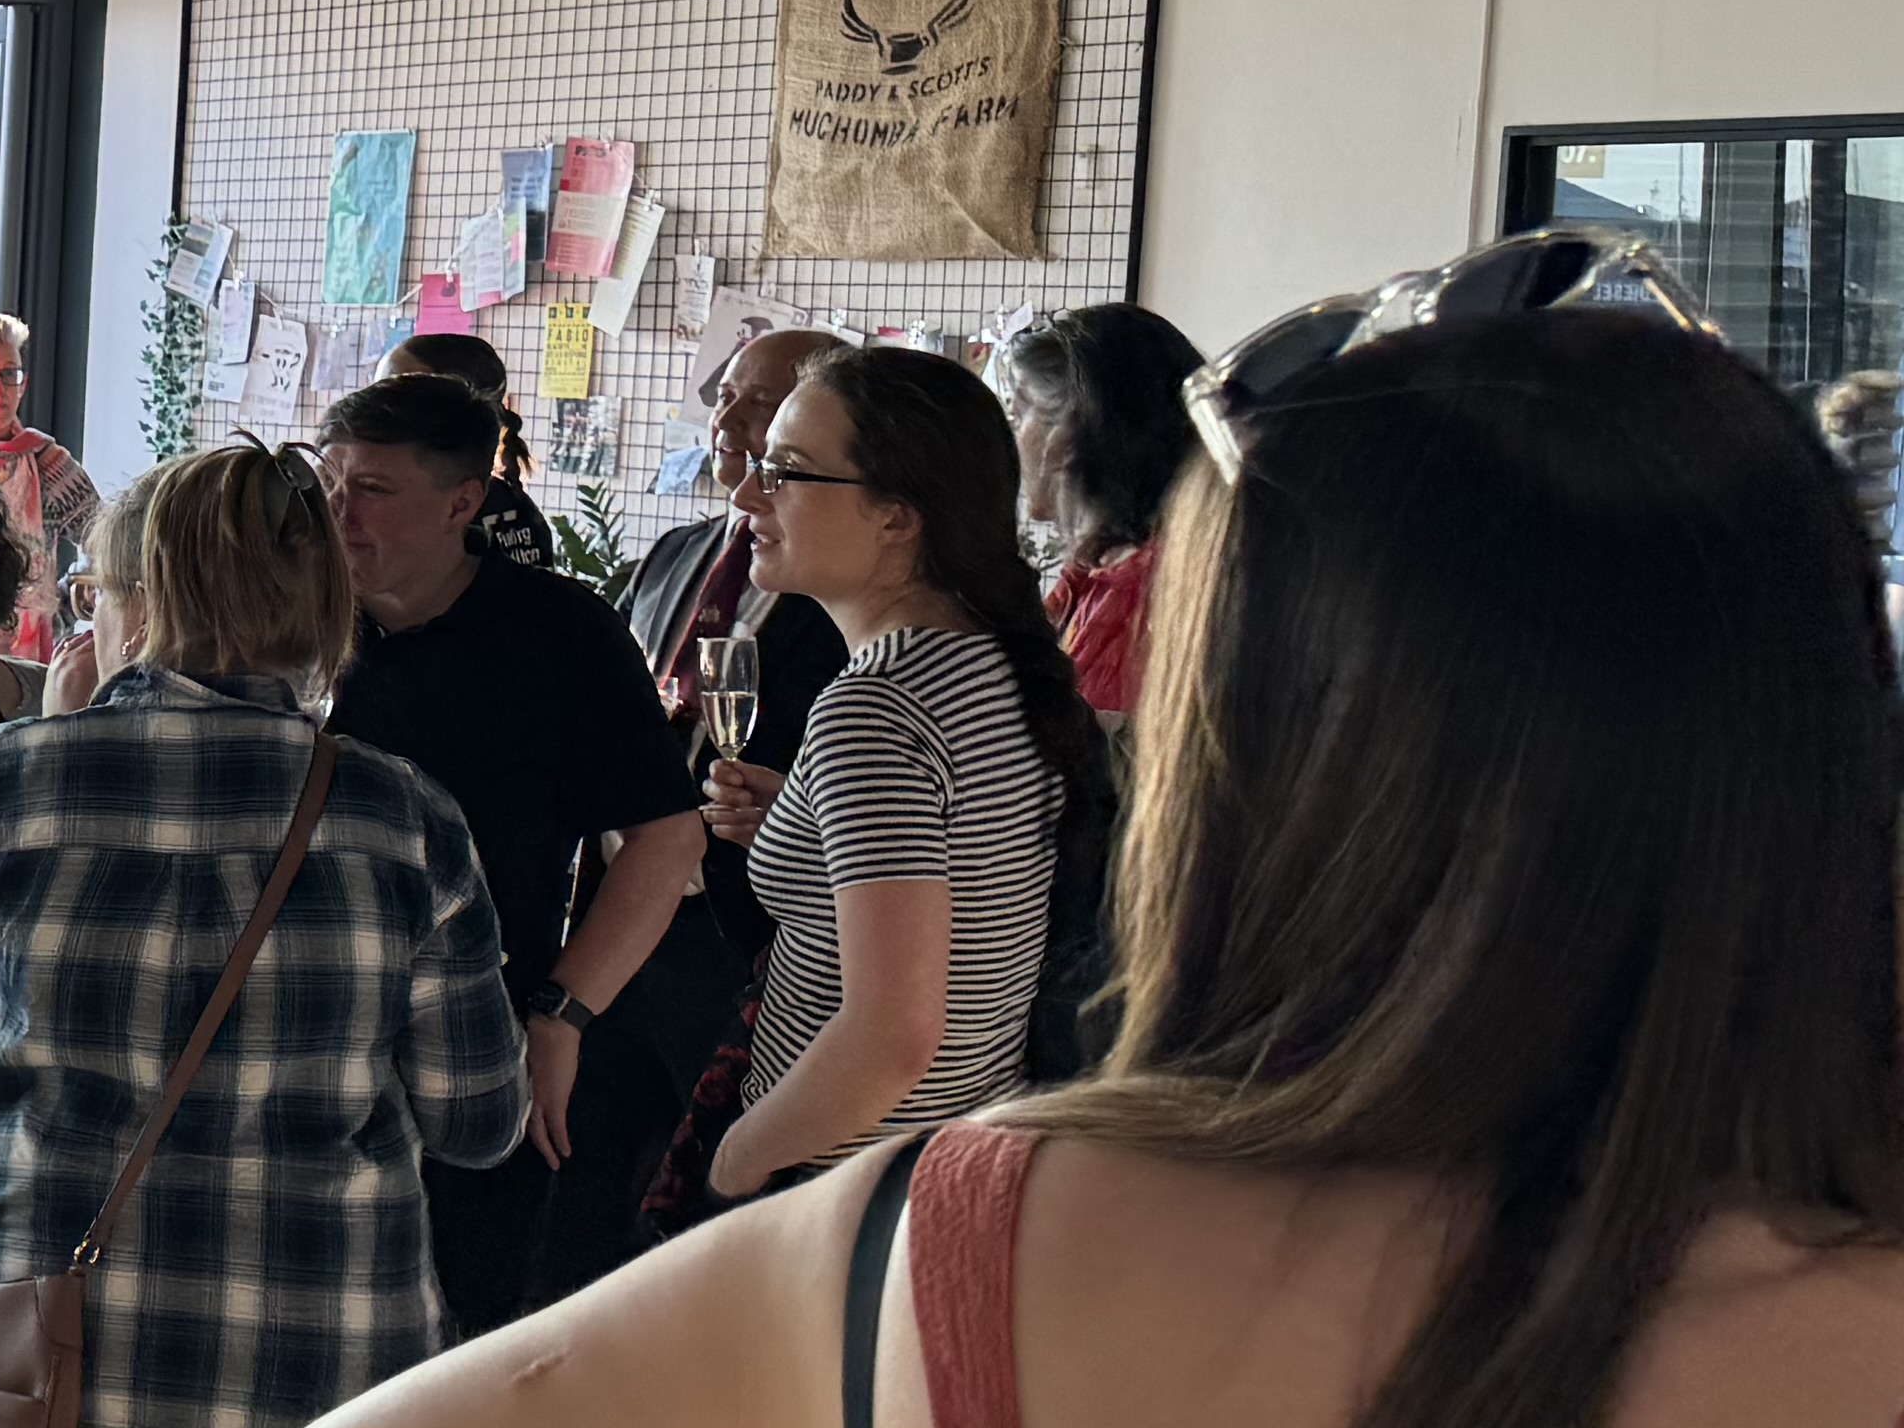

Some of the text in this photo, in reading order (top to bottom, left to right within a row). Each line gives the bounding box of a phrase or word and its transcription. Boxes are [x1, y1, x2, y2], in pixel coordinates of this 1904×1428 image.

[815, 79, 882, 104] PADDY
[908, 56, 991, 100] SCOTT'S
[932, 95, 1020, 136] FARM
